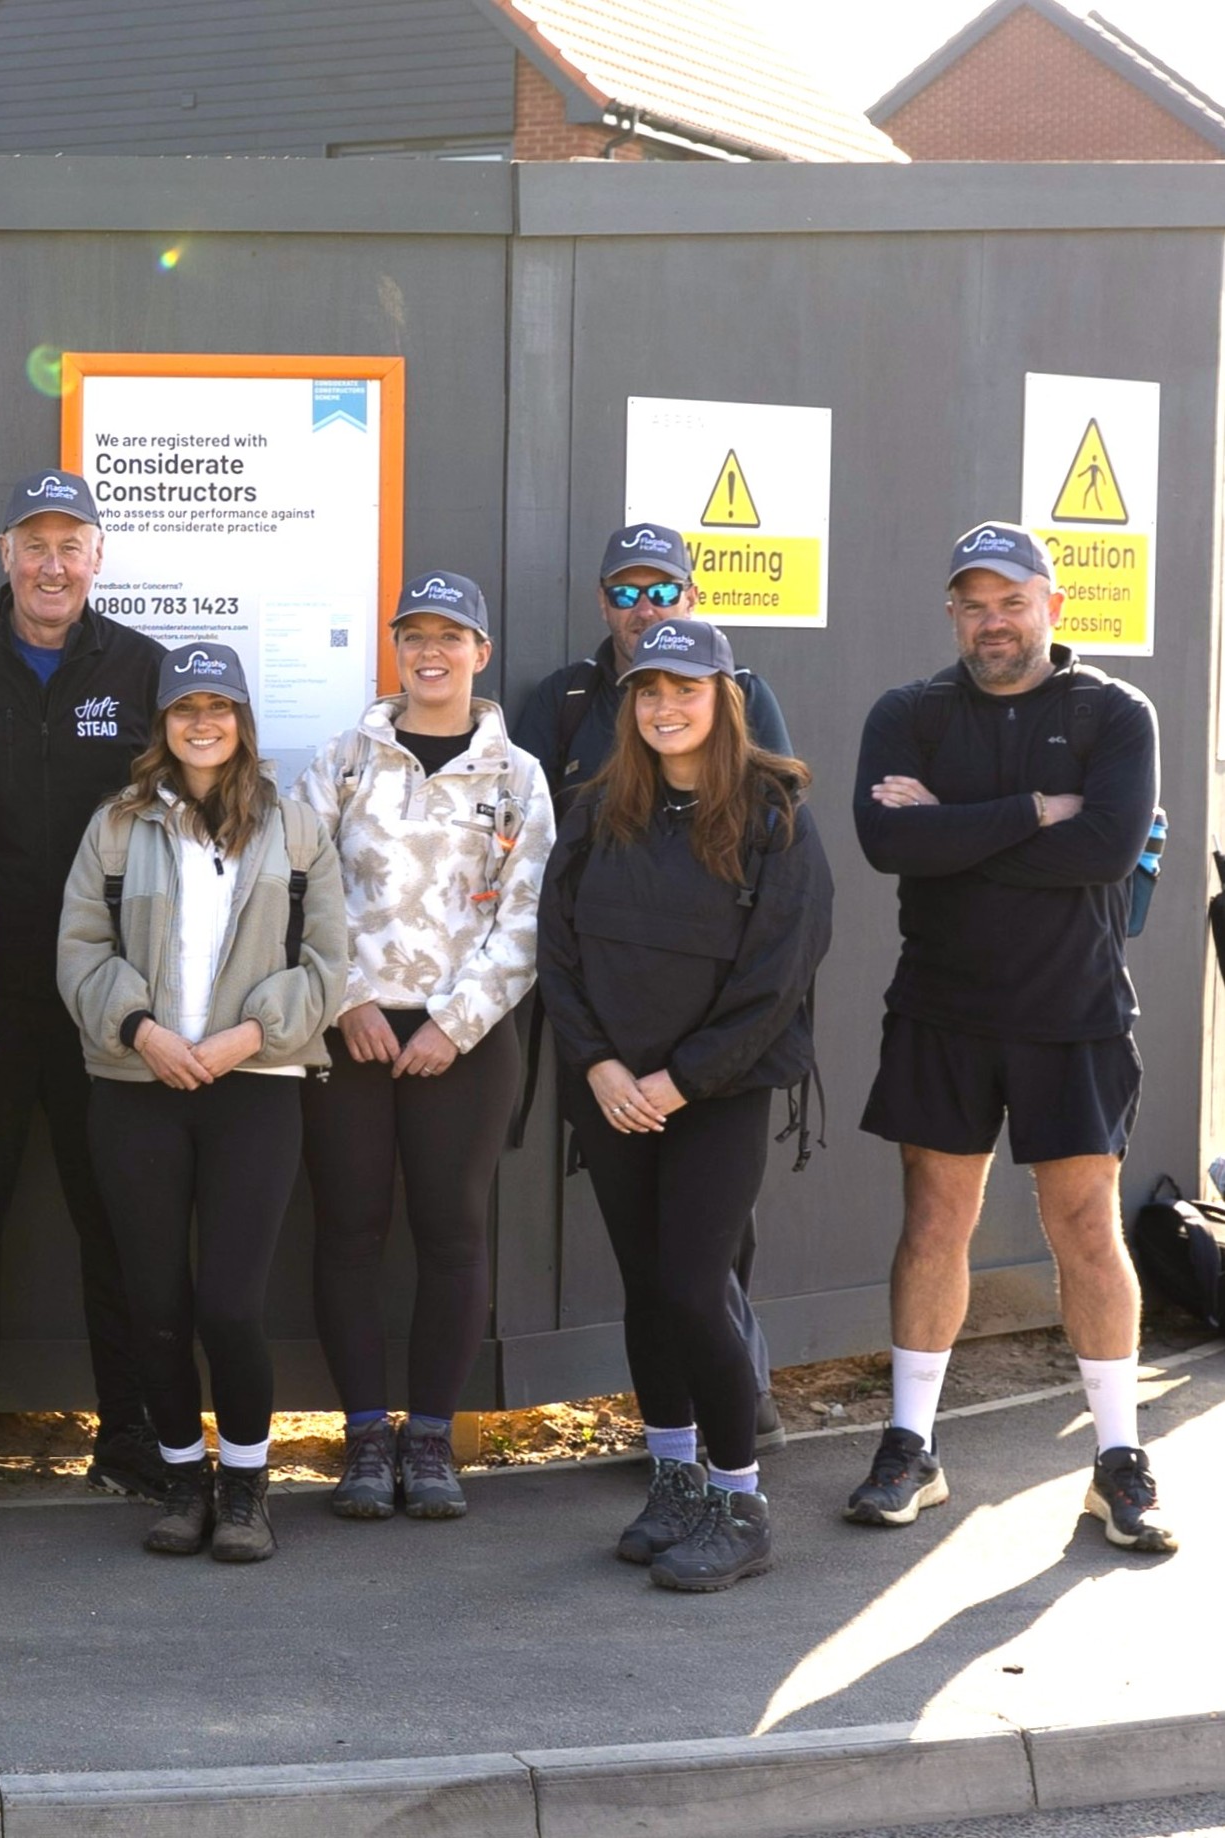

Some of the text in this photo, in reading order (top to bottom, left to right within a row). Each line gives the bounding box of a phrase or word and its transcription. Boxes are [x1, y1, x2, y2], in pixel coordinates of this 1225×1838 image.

[96, 433, 268, 450] We are registered with
[96, 453, 244, 474] Considerate
[46, 484, 78, 496] Flagship
[46, 491, 74, 500] Homes
[96, 480, 257, 502] Constructors
[97, 508, 315, 522] who assess our performance against
[105, 522, 278, 534] code of considerate practice
[639, 544, 668, 553] Homes
[641, 536, 672, 549] Flagship
[979, 544, 1009, 553] Homes
[980, 537, 1015, 548] Flagship
[94, 582, 131, 590] Feedback
[142, 582, 183, 590] Concerns?
[429, 586, 463, 598] Flagship
[1058, 581, 1131, 601] destrian
[428, 592, 457, 603] Homes
[712, 589, 779, 606] entrance
[95, 597, 240, 615] 0800 783 1423
[658, 642, 688, 651] Homes
[660, 634, 695, 647] Flagship
[193, 658, 227, 670] Flagship
[193, 667, 223, 676] Homes
[77, 721, 117, 737] STEAD
